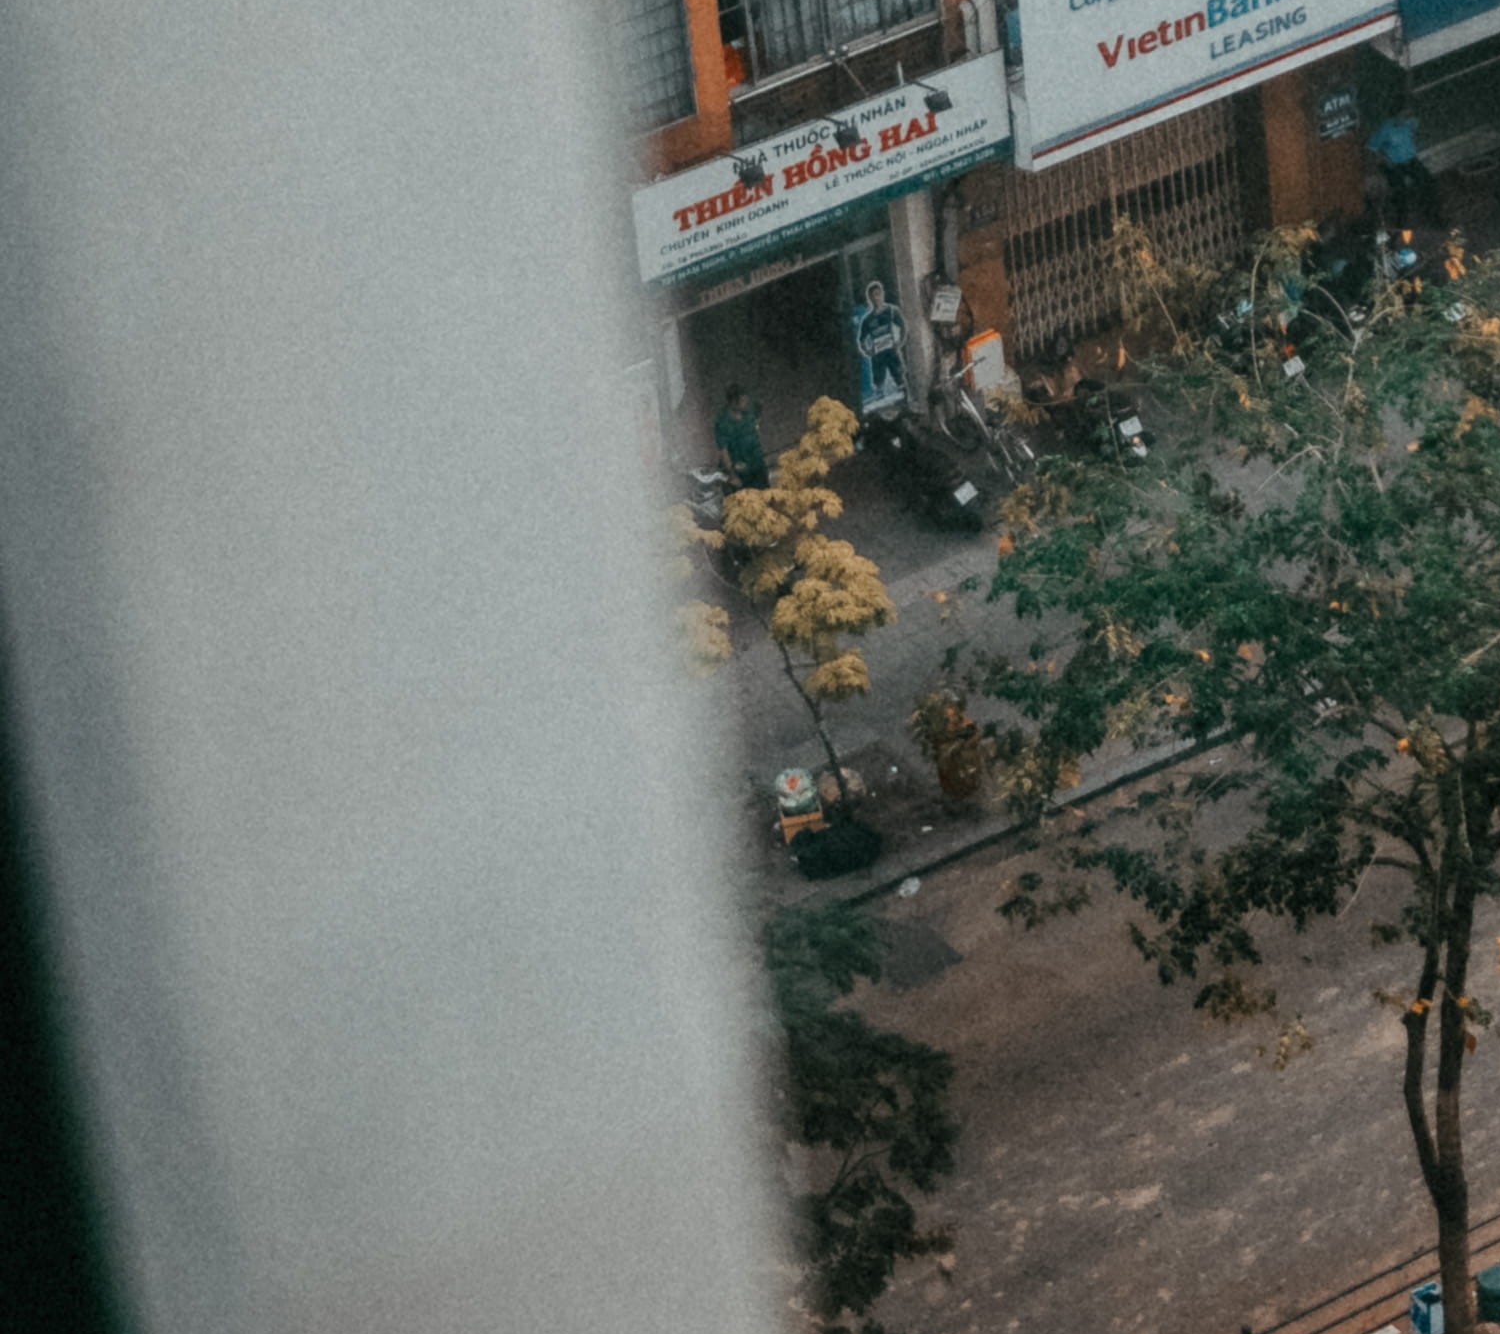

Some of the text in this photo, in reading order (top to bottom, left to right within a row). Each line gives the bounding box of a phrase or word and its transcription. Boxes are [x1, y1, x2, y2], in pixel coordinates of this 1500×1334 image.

[1210, 6, 1307, 60] LEASING
[772, 126, 830, 158] THUỐC
[860, 95, 906, 124] NHÂN
[783, 141, 871, 190] HỒNG
[660, 198, 789, 256] CHUYÊN KINH DOANH
